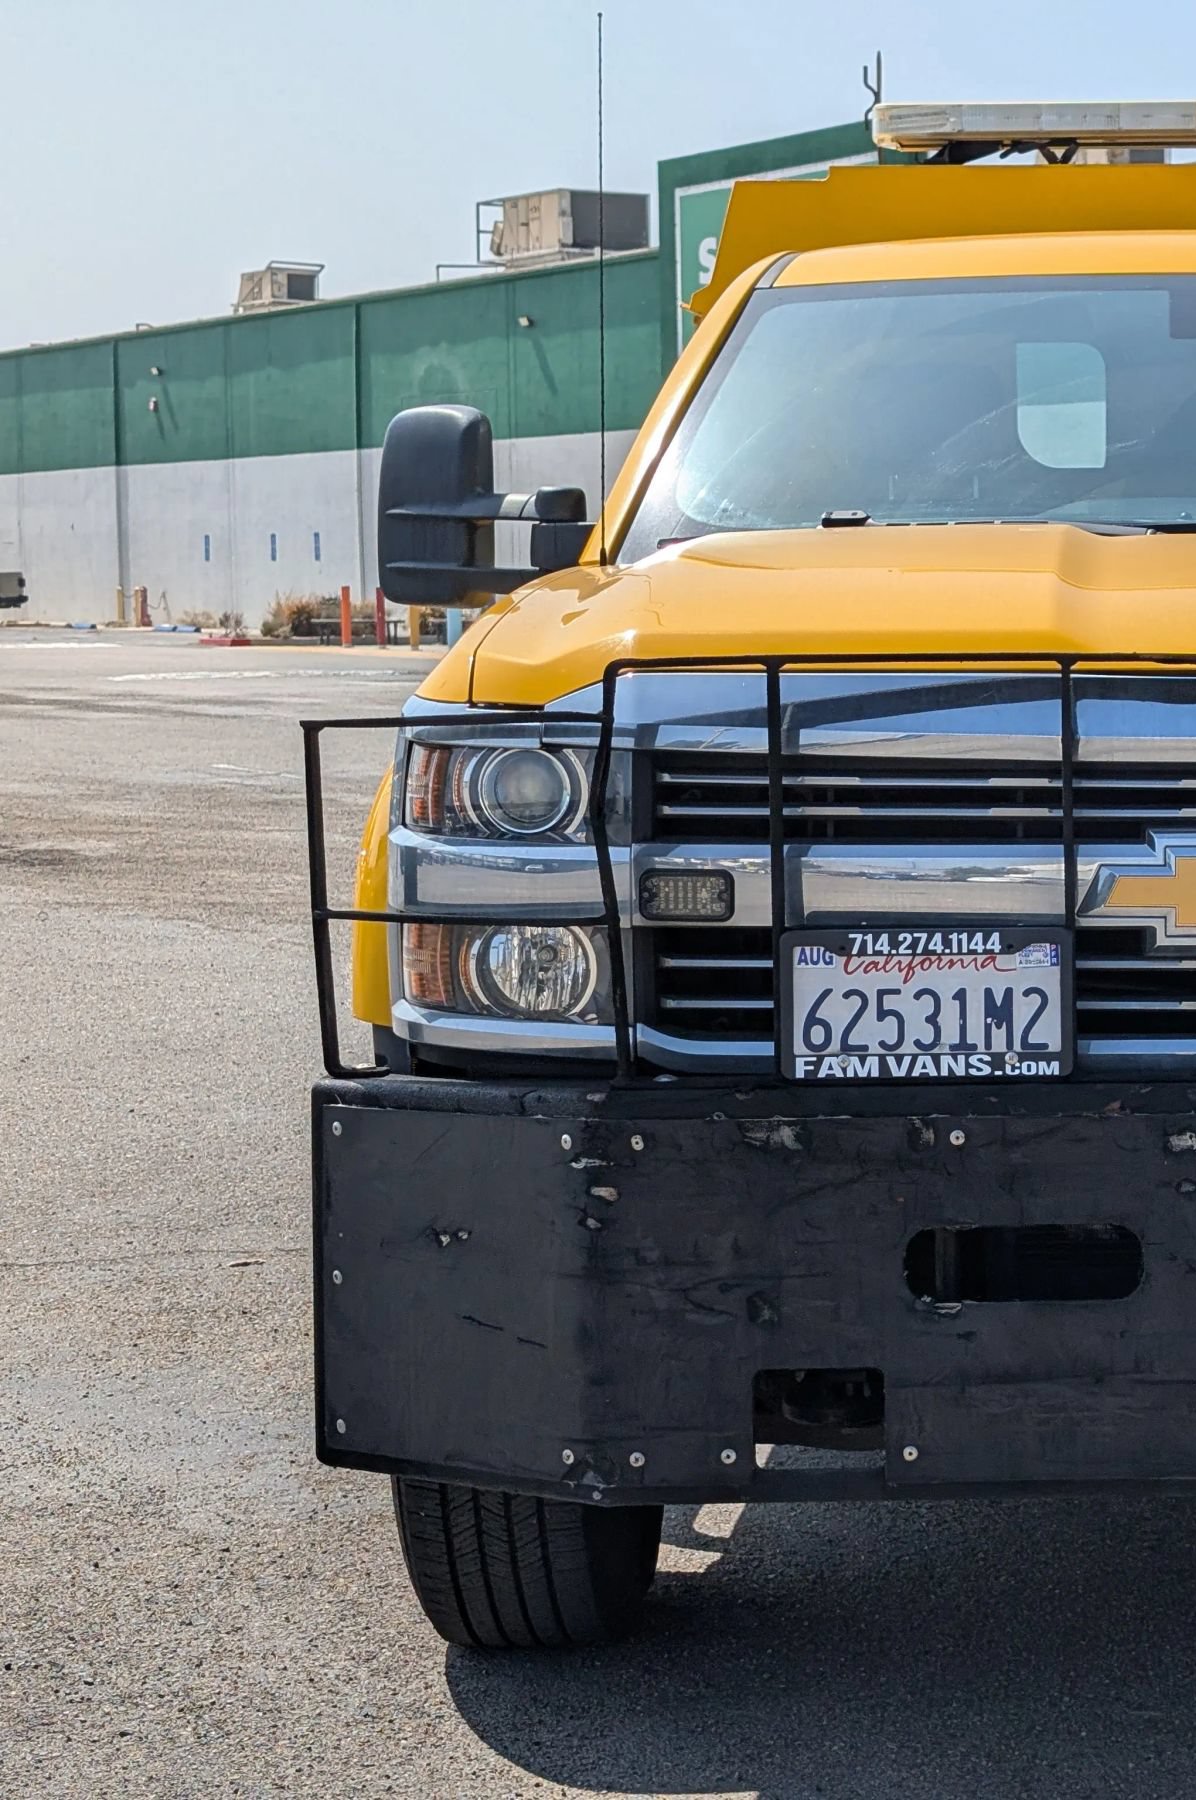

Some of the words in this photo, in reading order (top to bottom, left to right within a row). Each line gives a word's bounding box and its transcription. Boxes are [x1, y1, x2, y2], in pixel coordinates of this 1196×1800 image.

[797, 947, 834, 966] AUG
[848, 932, 1001, 955] 714.274.1144
[843, 953, 1017, 985] California
[802, 987, 1050, 1052] 62531M2
